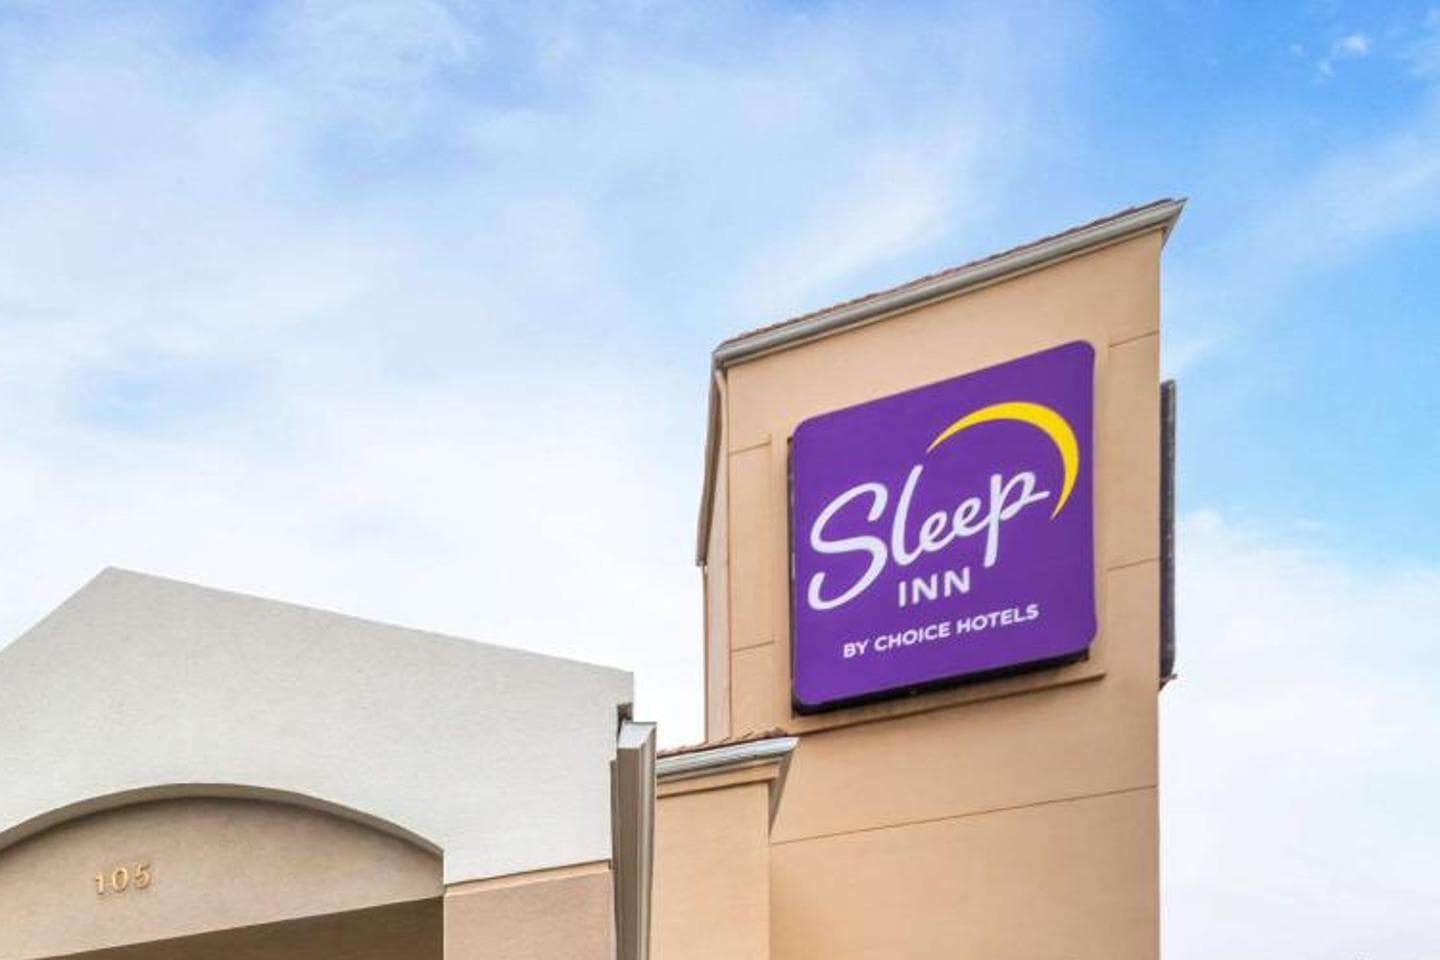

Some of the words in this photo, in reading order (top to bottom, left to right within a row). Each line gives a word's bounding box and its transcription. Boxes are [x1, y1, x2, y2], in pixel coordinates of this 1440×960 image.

[807, 463, 1051, 611] Sleep
[898, 566, 971, 608] INN
[842, 638, 869, 659] BY
[873, 621, 952, 652] CHOICE
[956, 603, 1040, 635] HOTELS
[95, 863, 151, 895] 105
